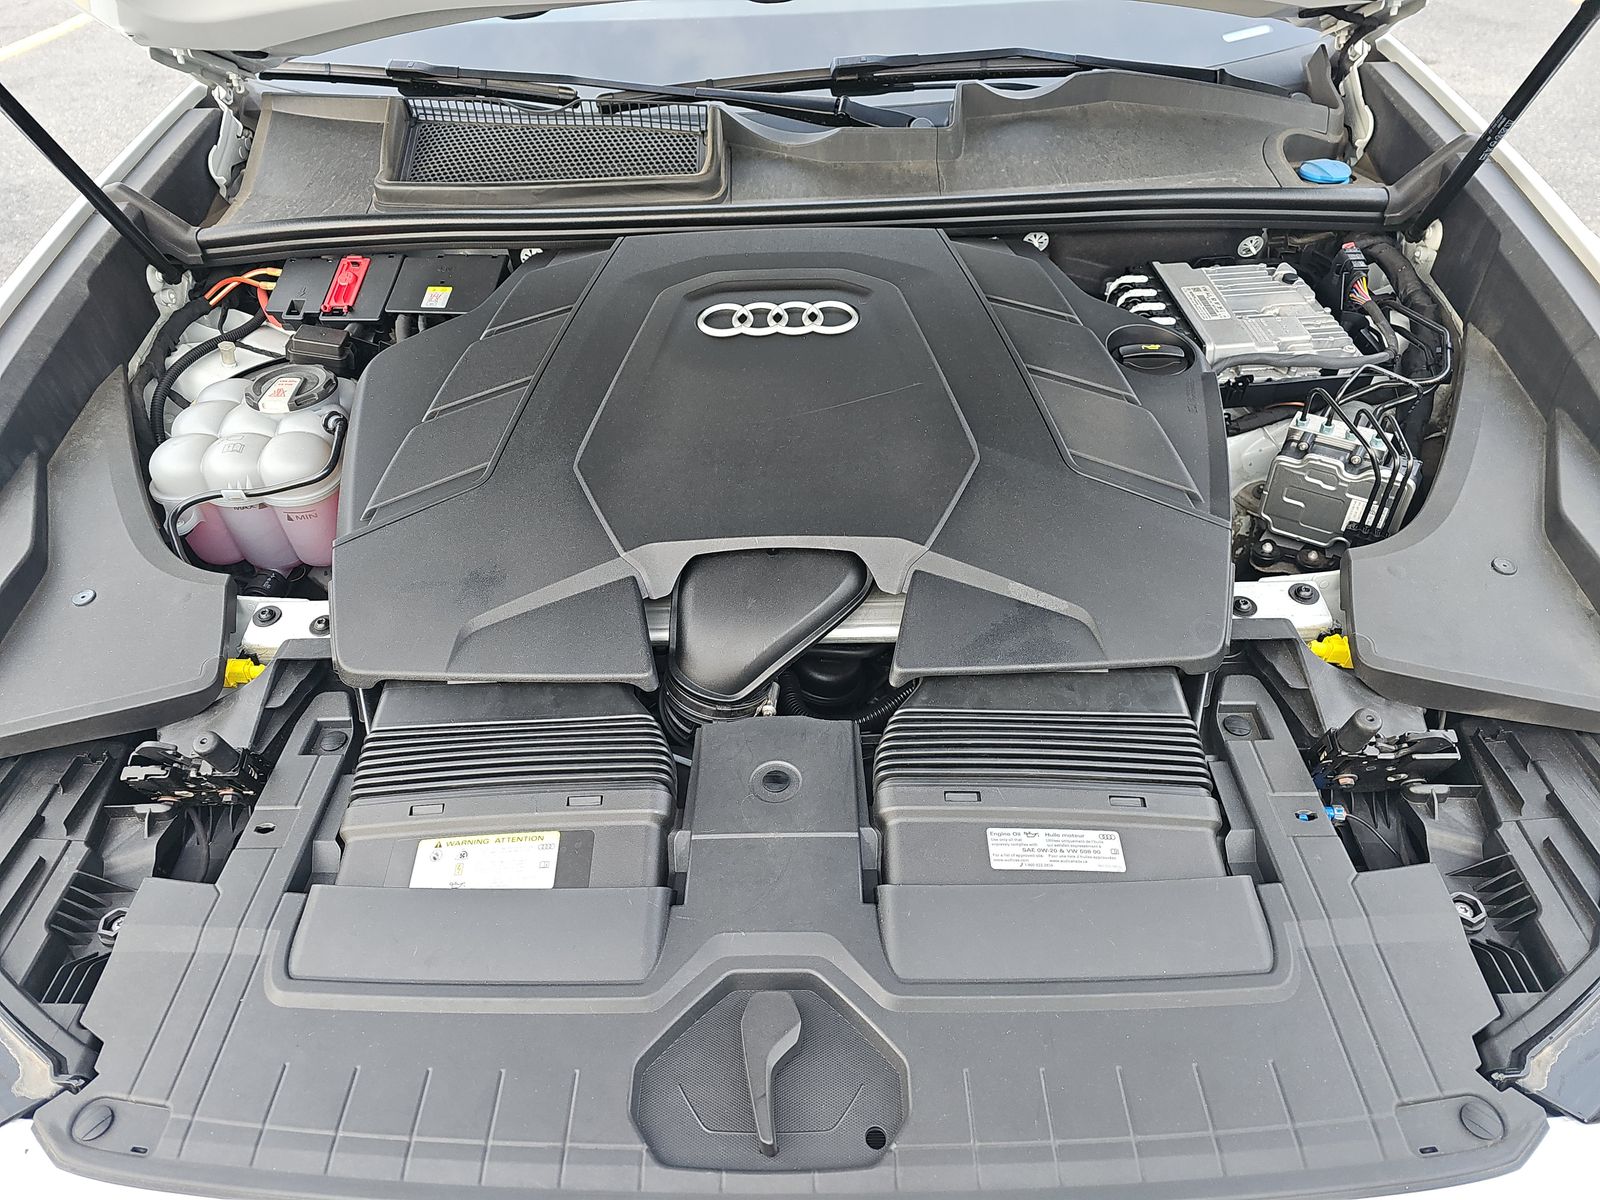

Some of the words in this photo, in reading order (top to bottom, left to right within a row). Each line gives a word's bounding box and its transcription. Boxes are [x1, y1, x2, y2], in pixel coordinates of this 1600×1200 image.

[295, 512, 319, 521] MIN
[446, 838, 490, 847] WARNING
[494, 835, 545, 844] ATTENTION
